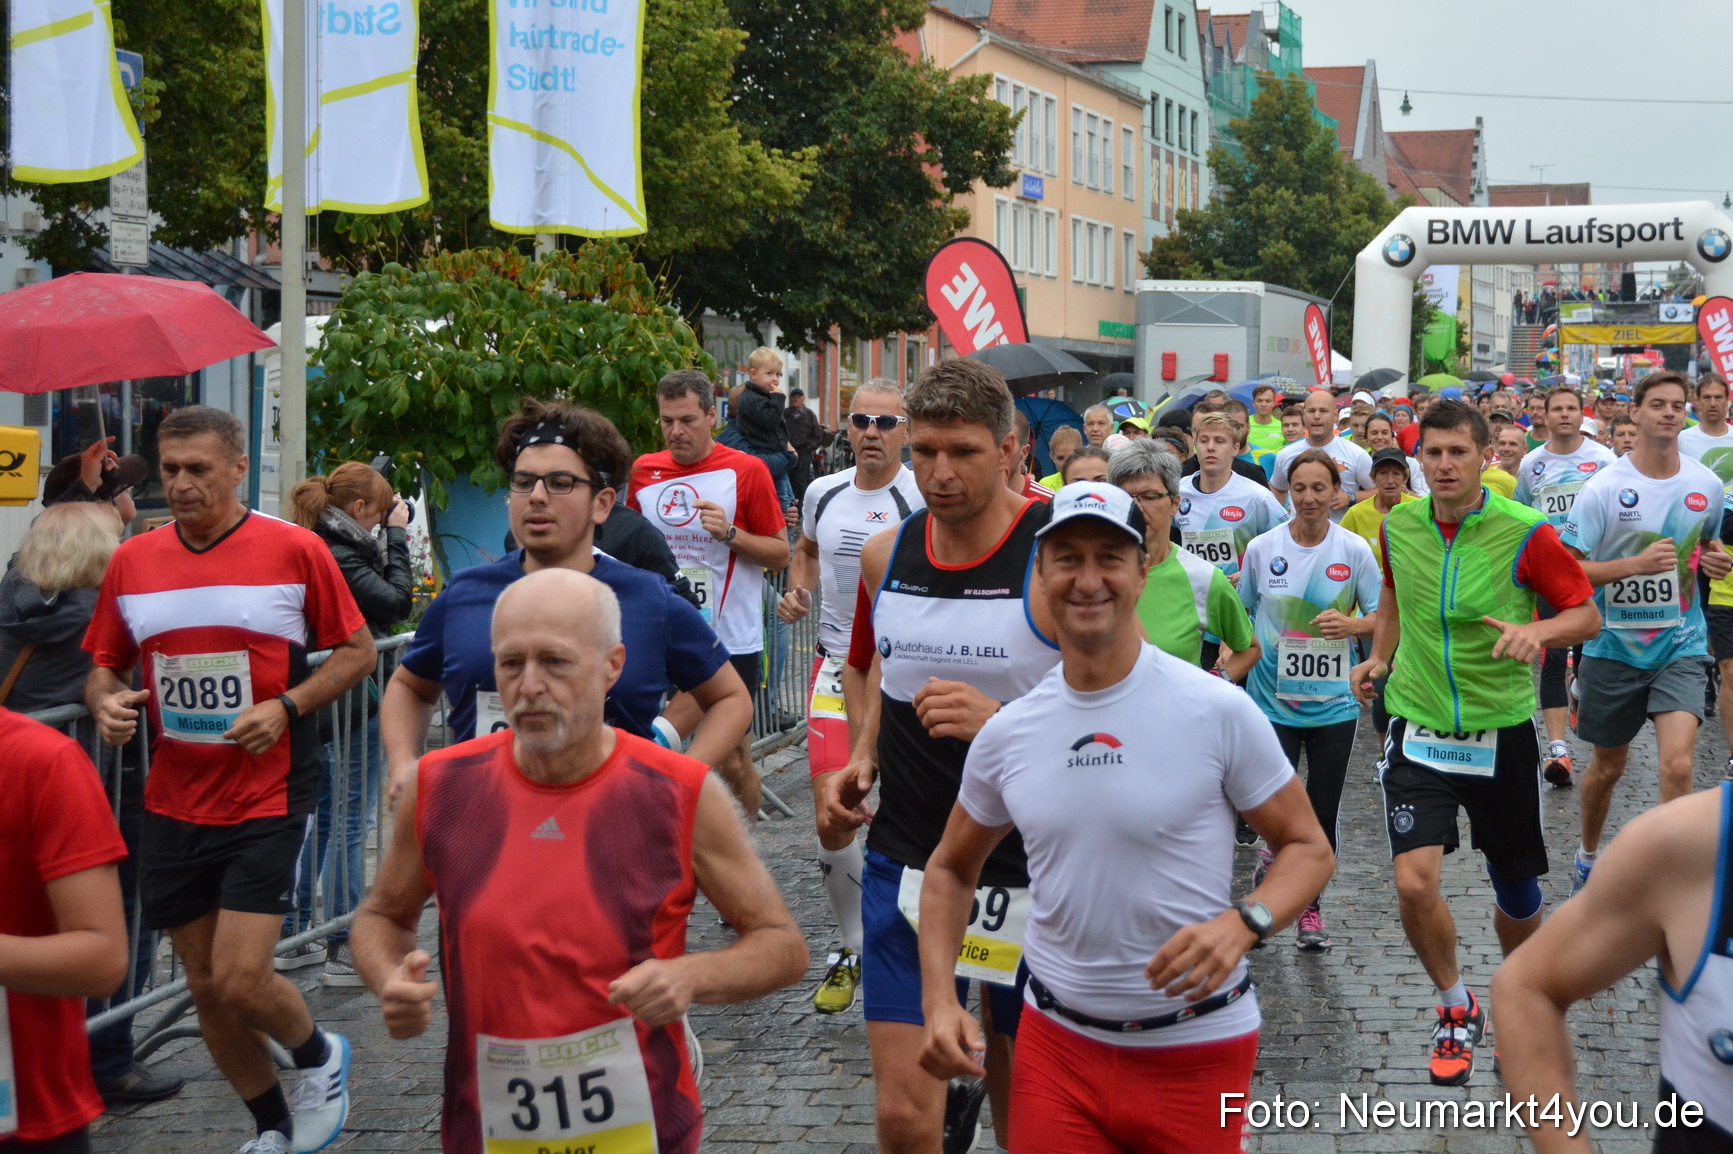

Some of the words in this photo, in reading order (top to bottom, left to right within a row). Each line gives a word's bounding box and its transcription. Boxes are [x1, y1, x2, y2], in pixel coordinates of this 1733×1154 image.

[1427, 219, 1516, 245] BMW
[1525, 217, 1684, 248] Laufsport
[1613, 329, 1644, 341] ZIEL
[1546, 492, 1579, 514] 207
[1619, 510, 1641, 518] PARTL
[1329, 567, 1349, 578] Hervis
[1612, 578, 1673, 604] 2369
[1621, 609, 1665, 620] Bernhard
[894, 640, 943, 654] Autohaus
[976, 646, 1009, 659] LELL
[186, 655, 240, 669] BOCK
[1286, 652, 1342, 678] 3061
[160, 675, 243, 710] 2089
[177, 717, 228, 732] Michael
[1067, 752, 1123, 768] skinfit
[1426, 746, 1472, 762] Thomas
[958, 941, 990, 961] rice
[538, 1028, 621, 1062] BOCK
[507, 1067, 615, 1132] 315
